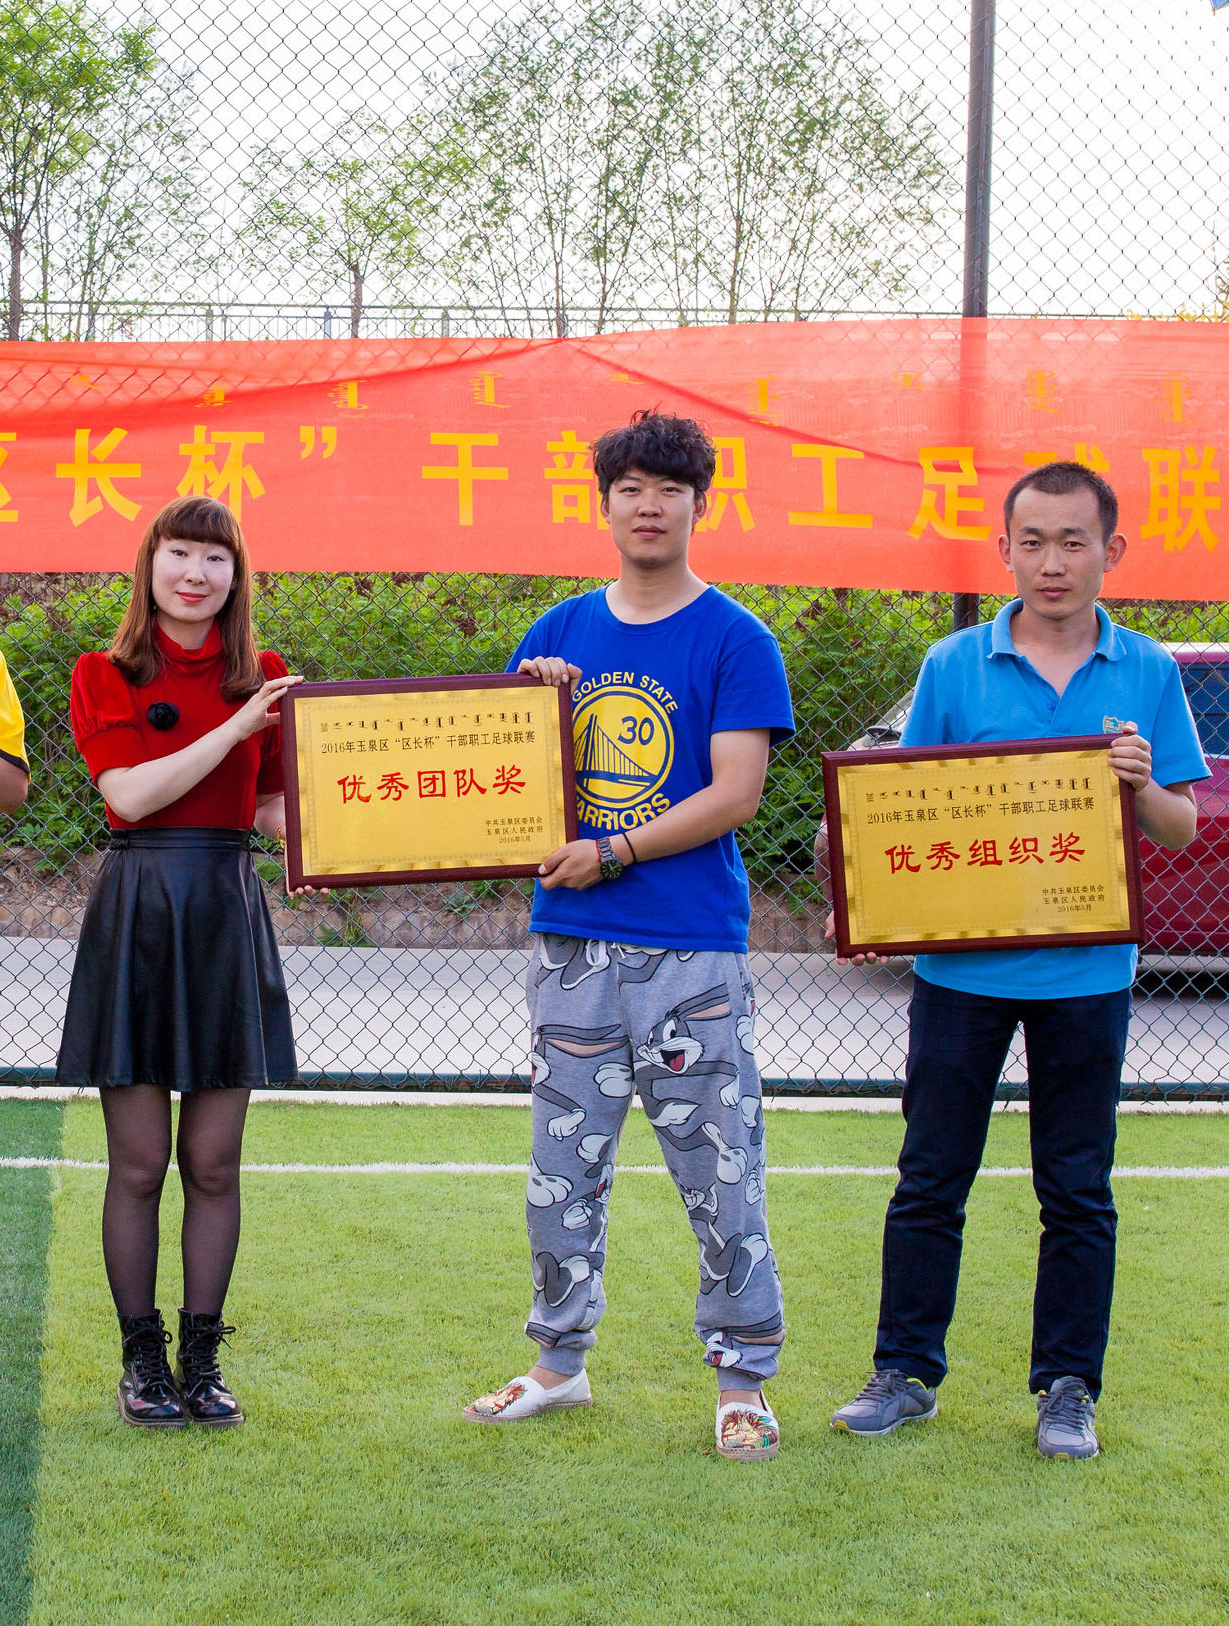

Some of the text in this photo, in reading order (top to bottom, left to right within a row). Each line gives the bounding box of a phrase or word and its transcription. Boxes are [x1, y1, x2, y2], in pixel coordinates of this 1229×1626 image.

[572, 671, 678, 715] GOLDEN STATE
[617, 716, 655, 746] 30
[337, 764, 527, 804] 优秀团队奖
[576, 792, 670, 831] ARRIORS
[884, 831, 1086, 874] 优秀组织奖
